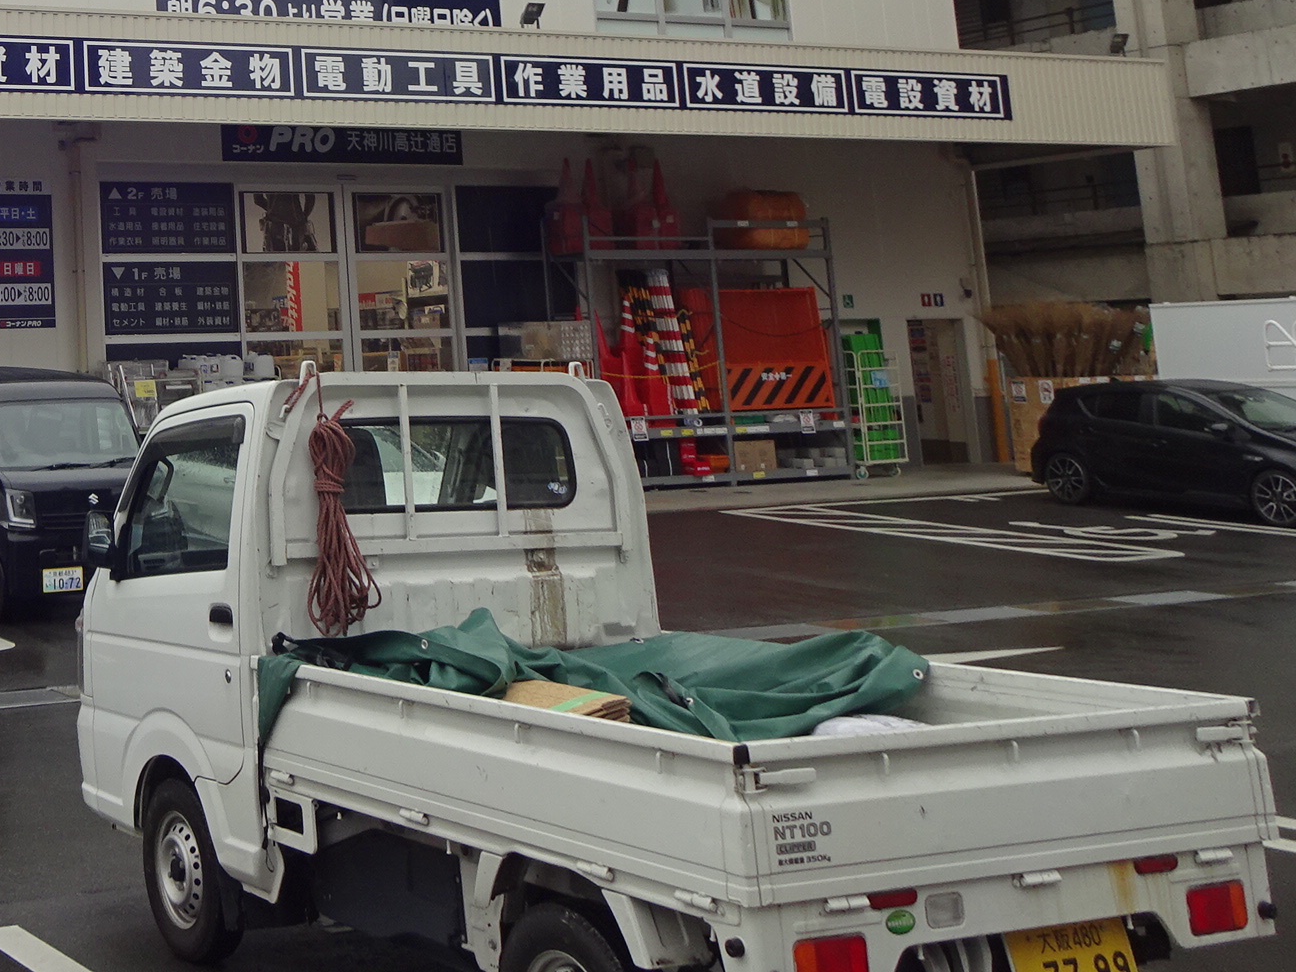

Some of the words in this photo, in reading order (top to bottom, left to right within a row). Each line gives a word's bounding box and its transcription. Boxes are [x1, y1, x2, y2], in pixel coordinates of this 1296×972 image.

[97, 48, 282, 90] 建築金物
[314, 56, 484, 96] 電動工具
[514, 62, 669, 102] 作業用品
[695, 70, 836, 109] 水道設備
[861, 78, 993, 113] 電設資材
[269, 126, 336, 153] PRO
[347, 131, 457, 154] 天神川高辻通店
[232, 144, 265, 154] コーナン
[127, 188, 145, 200] 2F
[150, 187, 178, 200] 売場
[26, 231, 48, 246] 8:00
[3, 262, 35, 275] 日曜日
[132, 267, 149, 280] 1F
[154, 267, 181, 280] 売場
[28, 286, 50, 301] 8:00
[112, 317, 146, 327] セメント
[53, 577, 81, 589] 10-72
[772, 811, 813, 823] NISSAN
[774, 821, 832, 841] NT100
